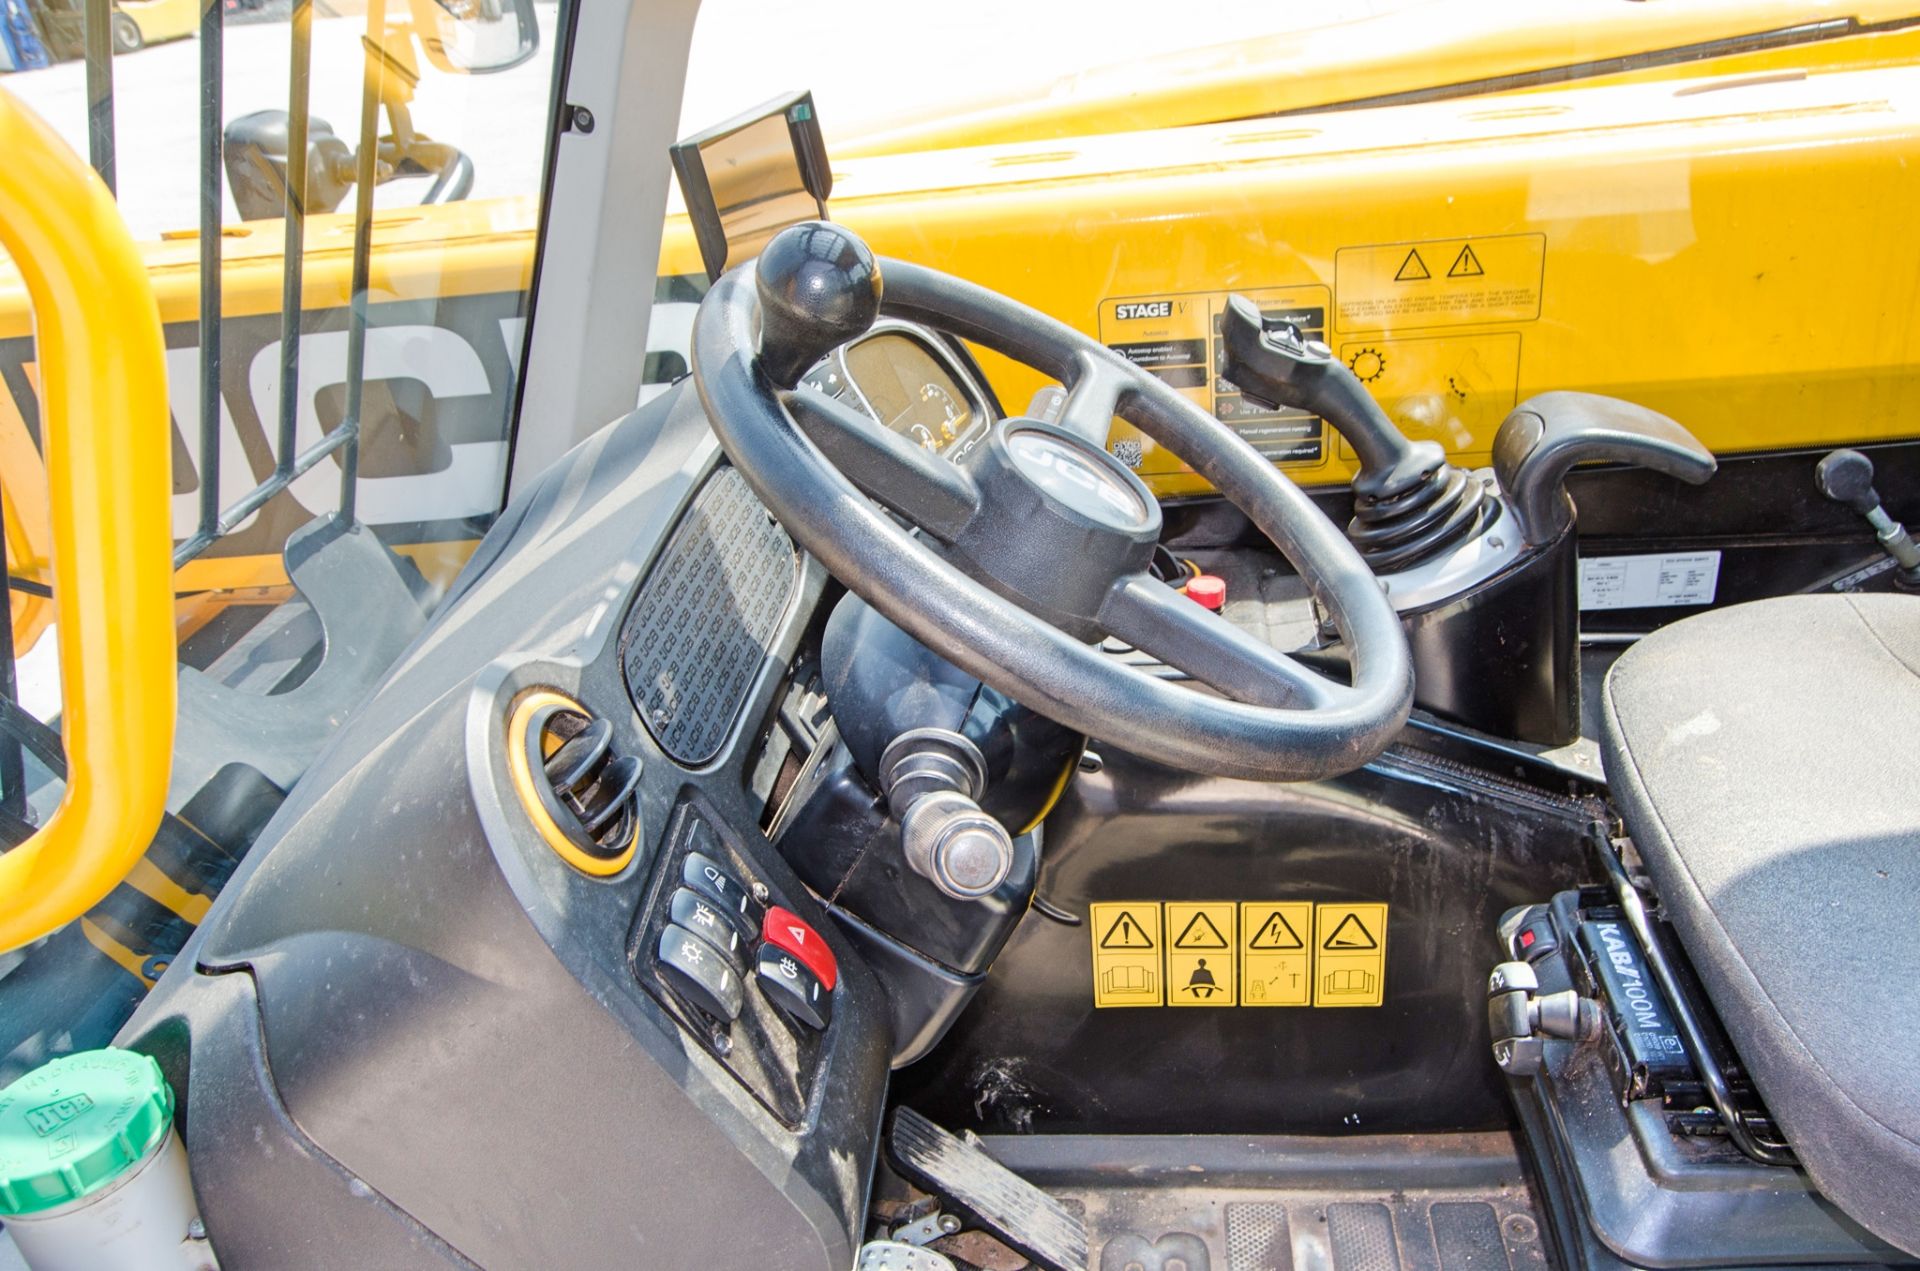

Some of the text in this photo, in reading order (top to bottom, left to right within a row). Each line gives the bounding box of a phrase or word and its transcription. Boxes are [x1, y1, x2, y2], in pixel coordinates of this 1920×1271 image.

[1117, 303, 1169, 319] STAGE
[654, 577, 671, 603] JCB
[668, 554, 686, 580] JCB
[684, 535, 698, 557] JCB
[697, 515, 710, 536] JCB
[709, 496, 723, 516] JCB
[1018, 449, 1137, 518] JCB
[641, 630, 659, 657] JCB
[657, 605, 674, 631] JCB
[672, 581, 688, 607] JCB
[686, 559, 700, 583] JCB
[701, 538, 714, 562] JCB
[713, 519, 726, 541] JCB
[724, 502, 738, 522] JCB
[643, 505, 752, 687] JCB JCB JCB JCB JCB JCB JCB JCB
[662, 662, 679, 689] JCB
[677, 636, 693, 662] JCB
[691, 613, 707, 637] JCB
[705, 589, 719, 613] JCB
[718, 568, 732, 590] JCB
[730, 548, 744, 569] JCB
[743, 529, 755, 549] JCB
[664, 534, 769, 720] JCB JCB JCB JCB JCB JCB JCB JCB
[668, 720, 686, 750] JCB
[683, 692, 700, 721] JCB
[698, 666, 714, 691] JCB
[711, 641, 726, 666] JCB
[724, 618, 738, 642] JCB
[749, 575, 762, 596] JCB
[759, 554, 772, 576] JCB
[686, 721, 704, 750] JCB
[701, 694, 717, 721] JCB
[715, 668, 730, 695] JCB
[727, 644, 742, 669] JCB
[751, 600, 765, 620] JCB
[762, 578, 775, 599] JCB
[773, 559, 786, 579] JCB
[704, 722, 720, 750] JCB
[719, 696, 734, 722] JCB
[731, 671, 746, 697] JCB
[744, 647, 757, 671] JCB
[766, 605, 779, 624] JCB
[777, 583, 788, 603] JCB
